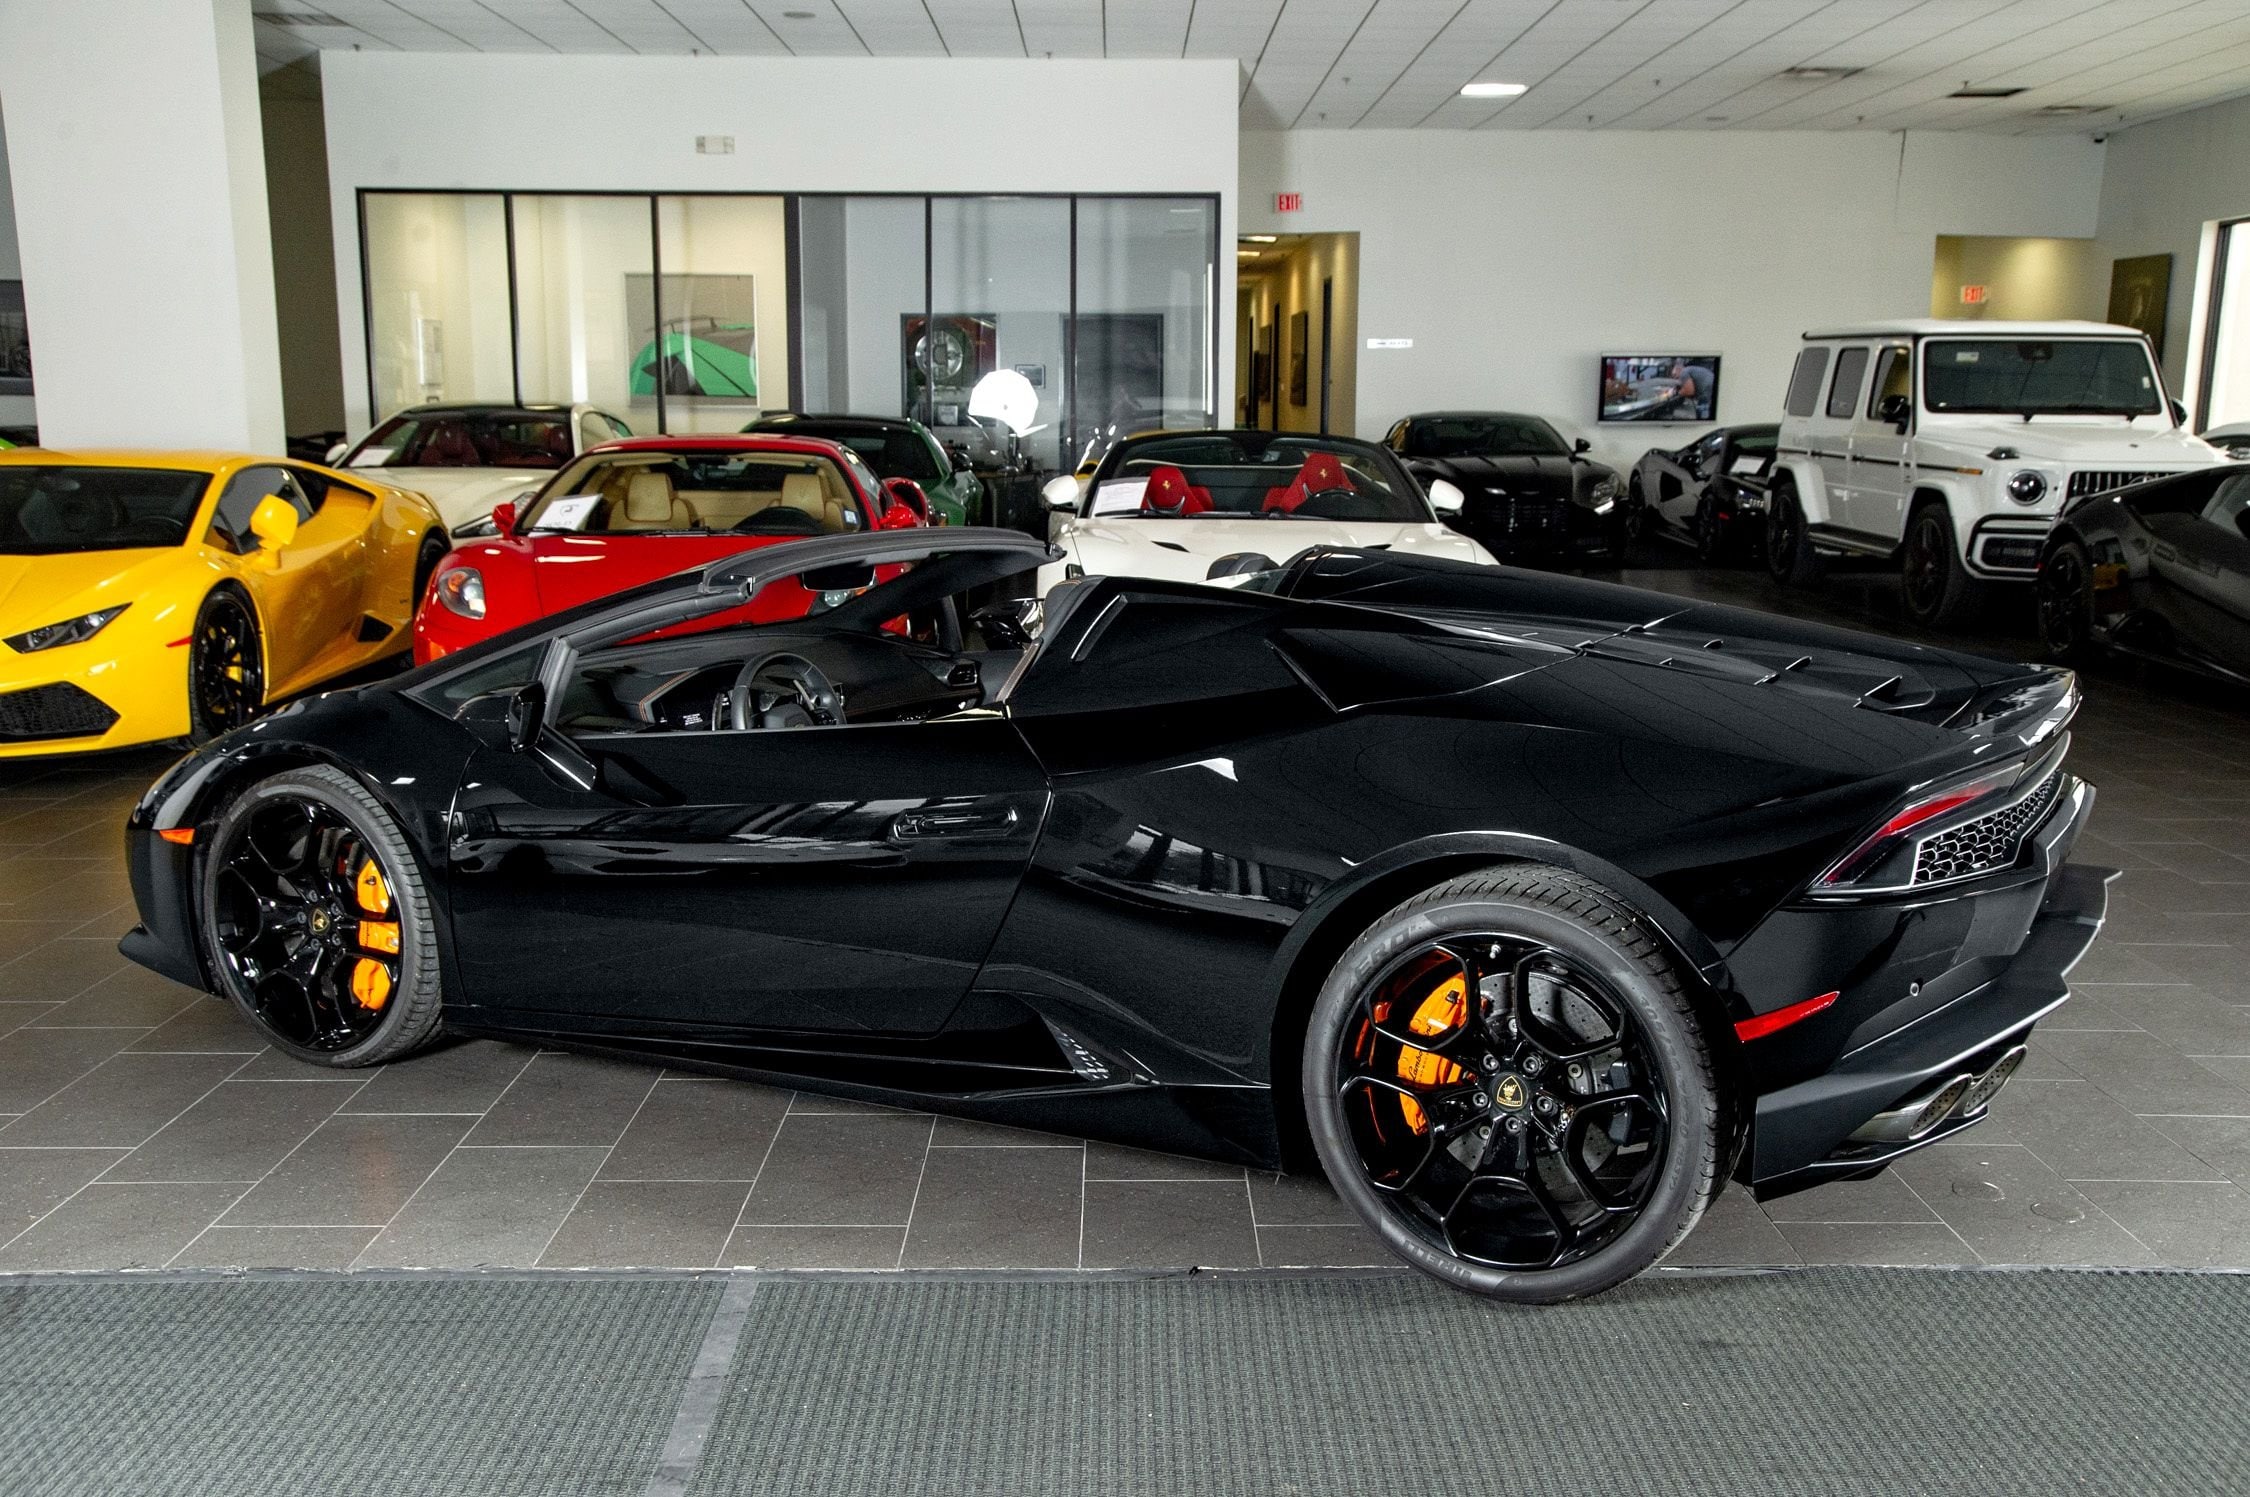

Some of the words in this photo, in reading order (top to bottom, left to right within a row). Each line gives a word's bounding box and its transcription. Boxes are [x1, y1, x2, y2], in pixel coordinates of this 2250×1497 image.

[1279, 194, 1300, 211] EXIT
[1964, 286, 1985, 303] EXIT
[1343, 926, 1409, 1001] ZERO
[1402, 1239, 1472, 1284] PIRELLI
